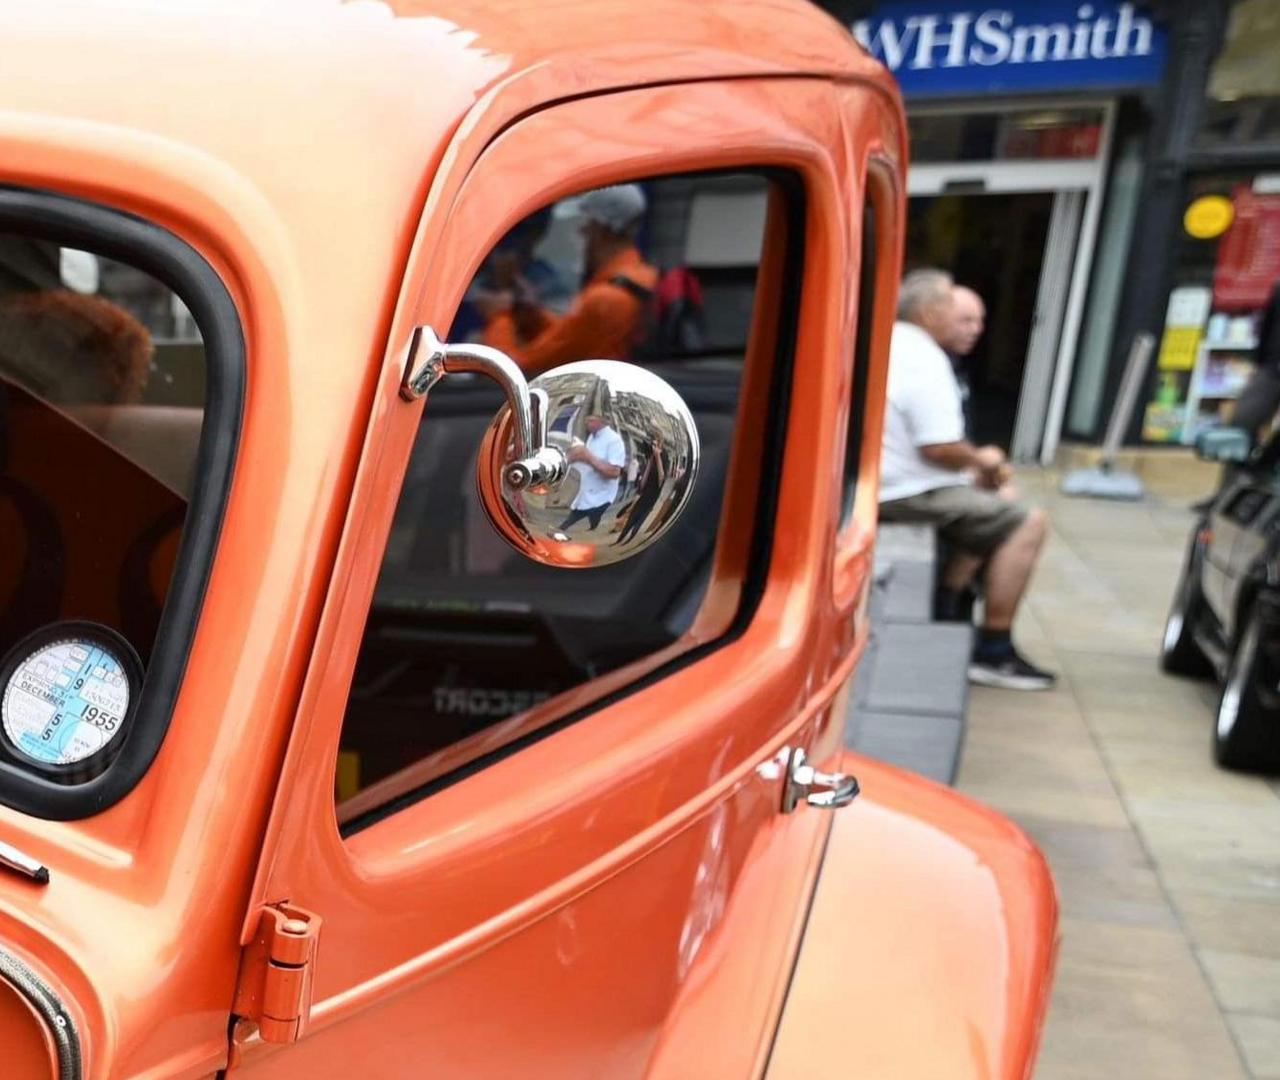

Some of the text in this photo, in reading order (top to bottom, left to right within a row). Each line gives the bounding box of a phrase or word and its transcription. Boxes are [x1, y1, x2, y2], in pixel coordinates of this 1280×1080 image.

[852, 3, 1153, 71] WHSmith
[21, 680, 66, 708] DECEMBER
[81, 704, 118, 731] 1955
